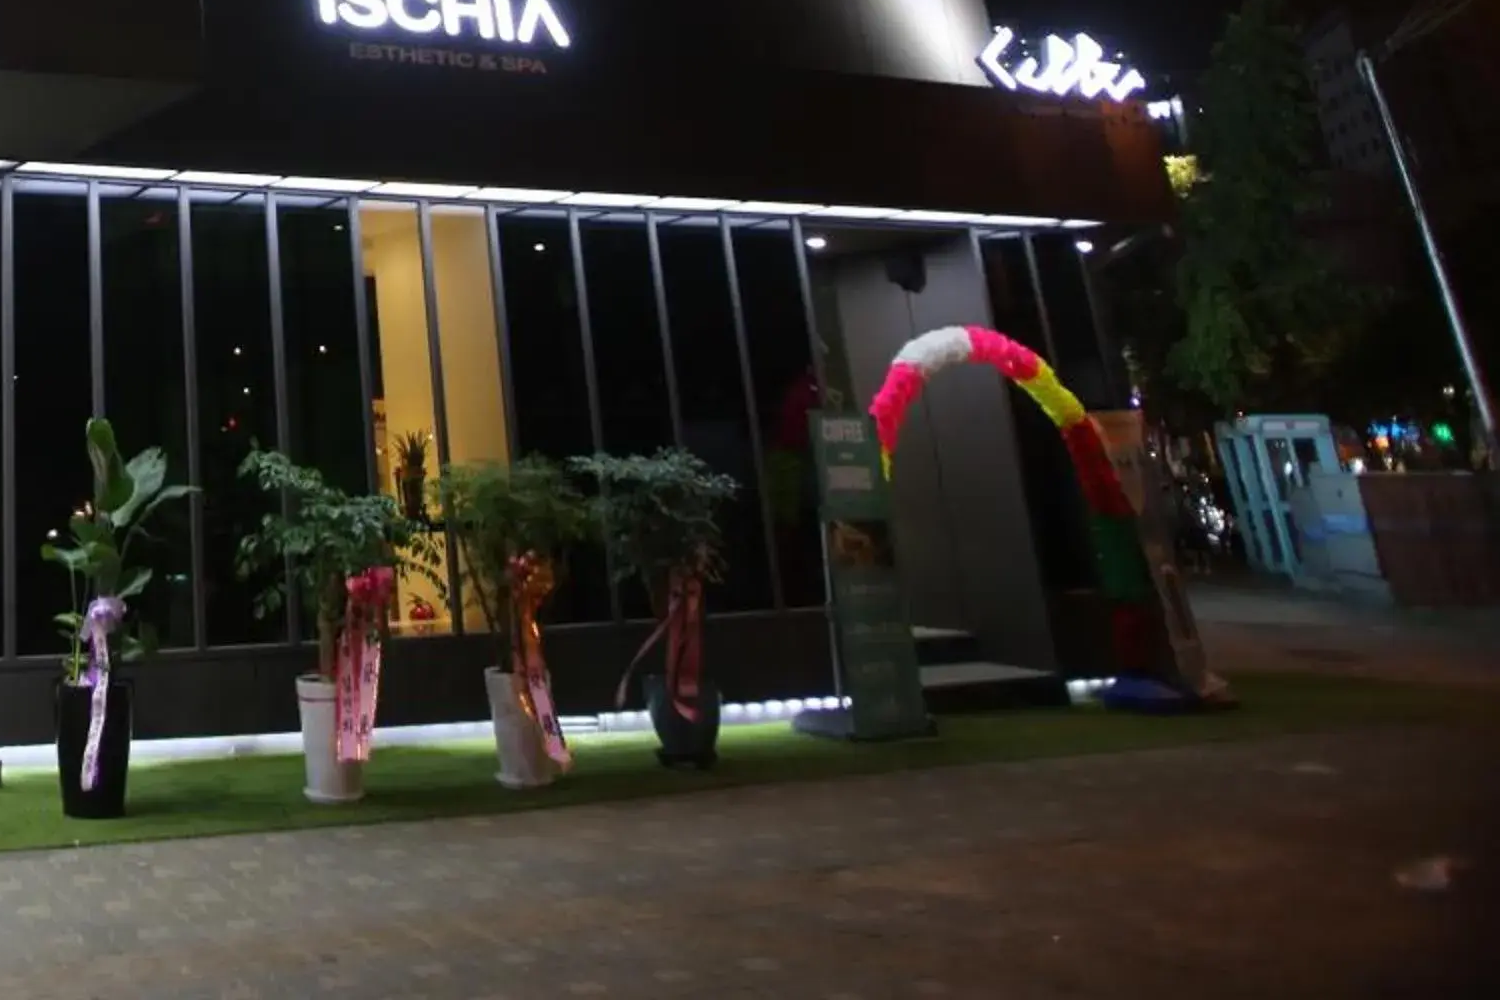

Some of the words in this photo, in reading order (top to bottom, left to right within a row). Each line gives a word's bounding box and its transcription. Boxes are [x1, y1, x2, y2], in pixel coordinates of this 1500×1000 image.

[349, 44, 475, 68] ESTHETIC
[479, 56, 498, 71] &
[501, 55, 547, 74] SPA
